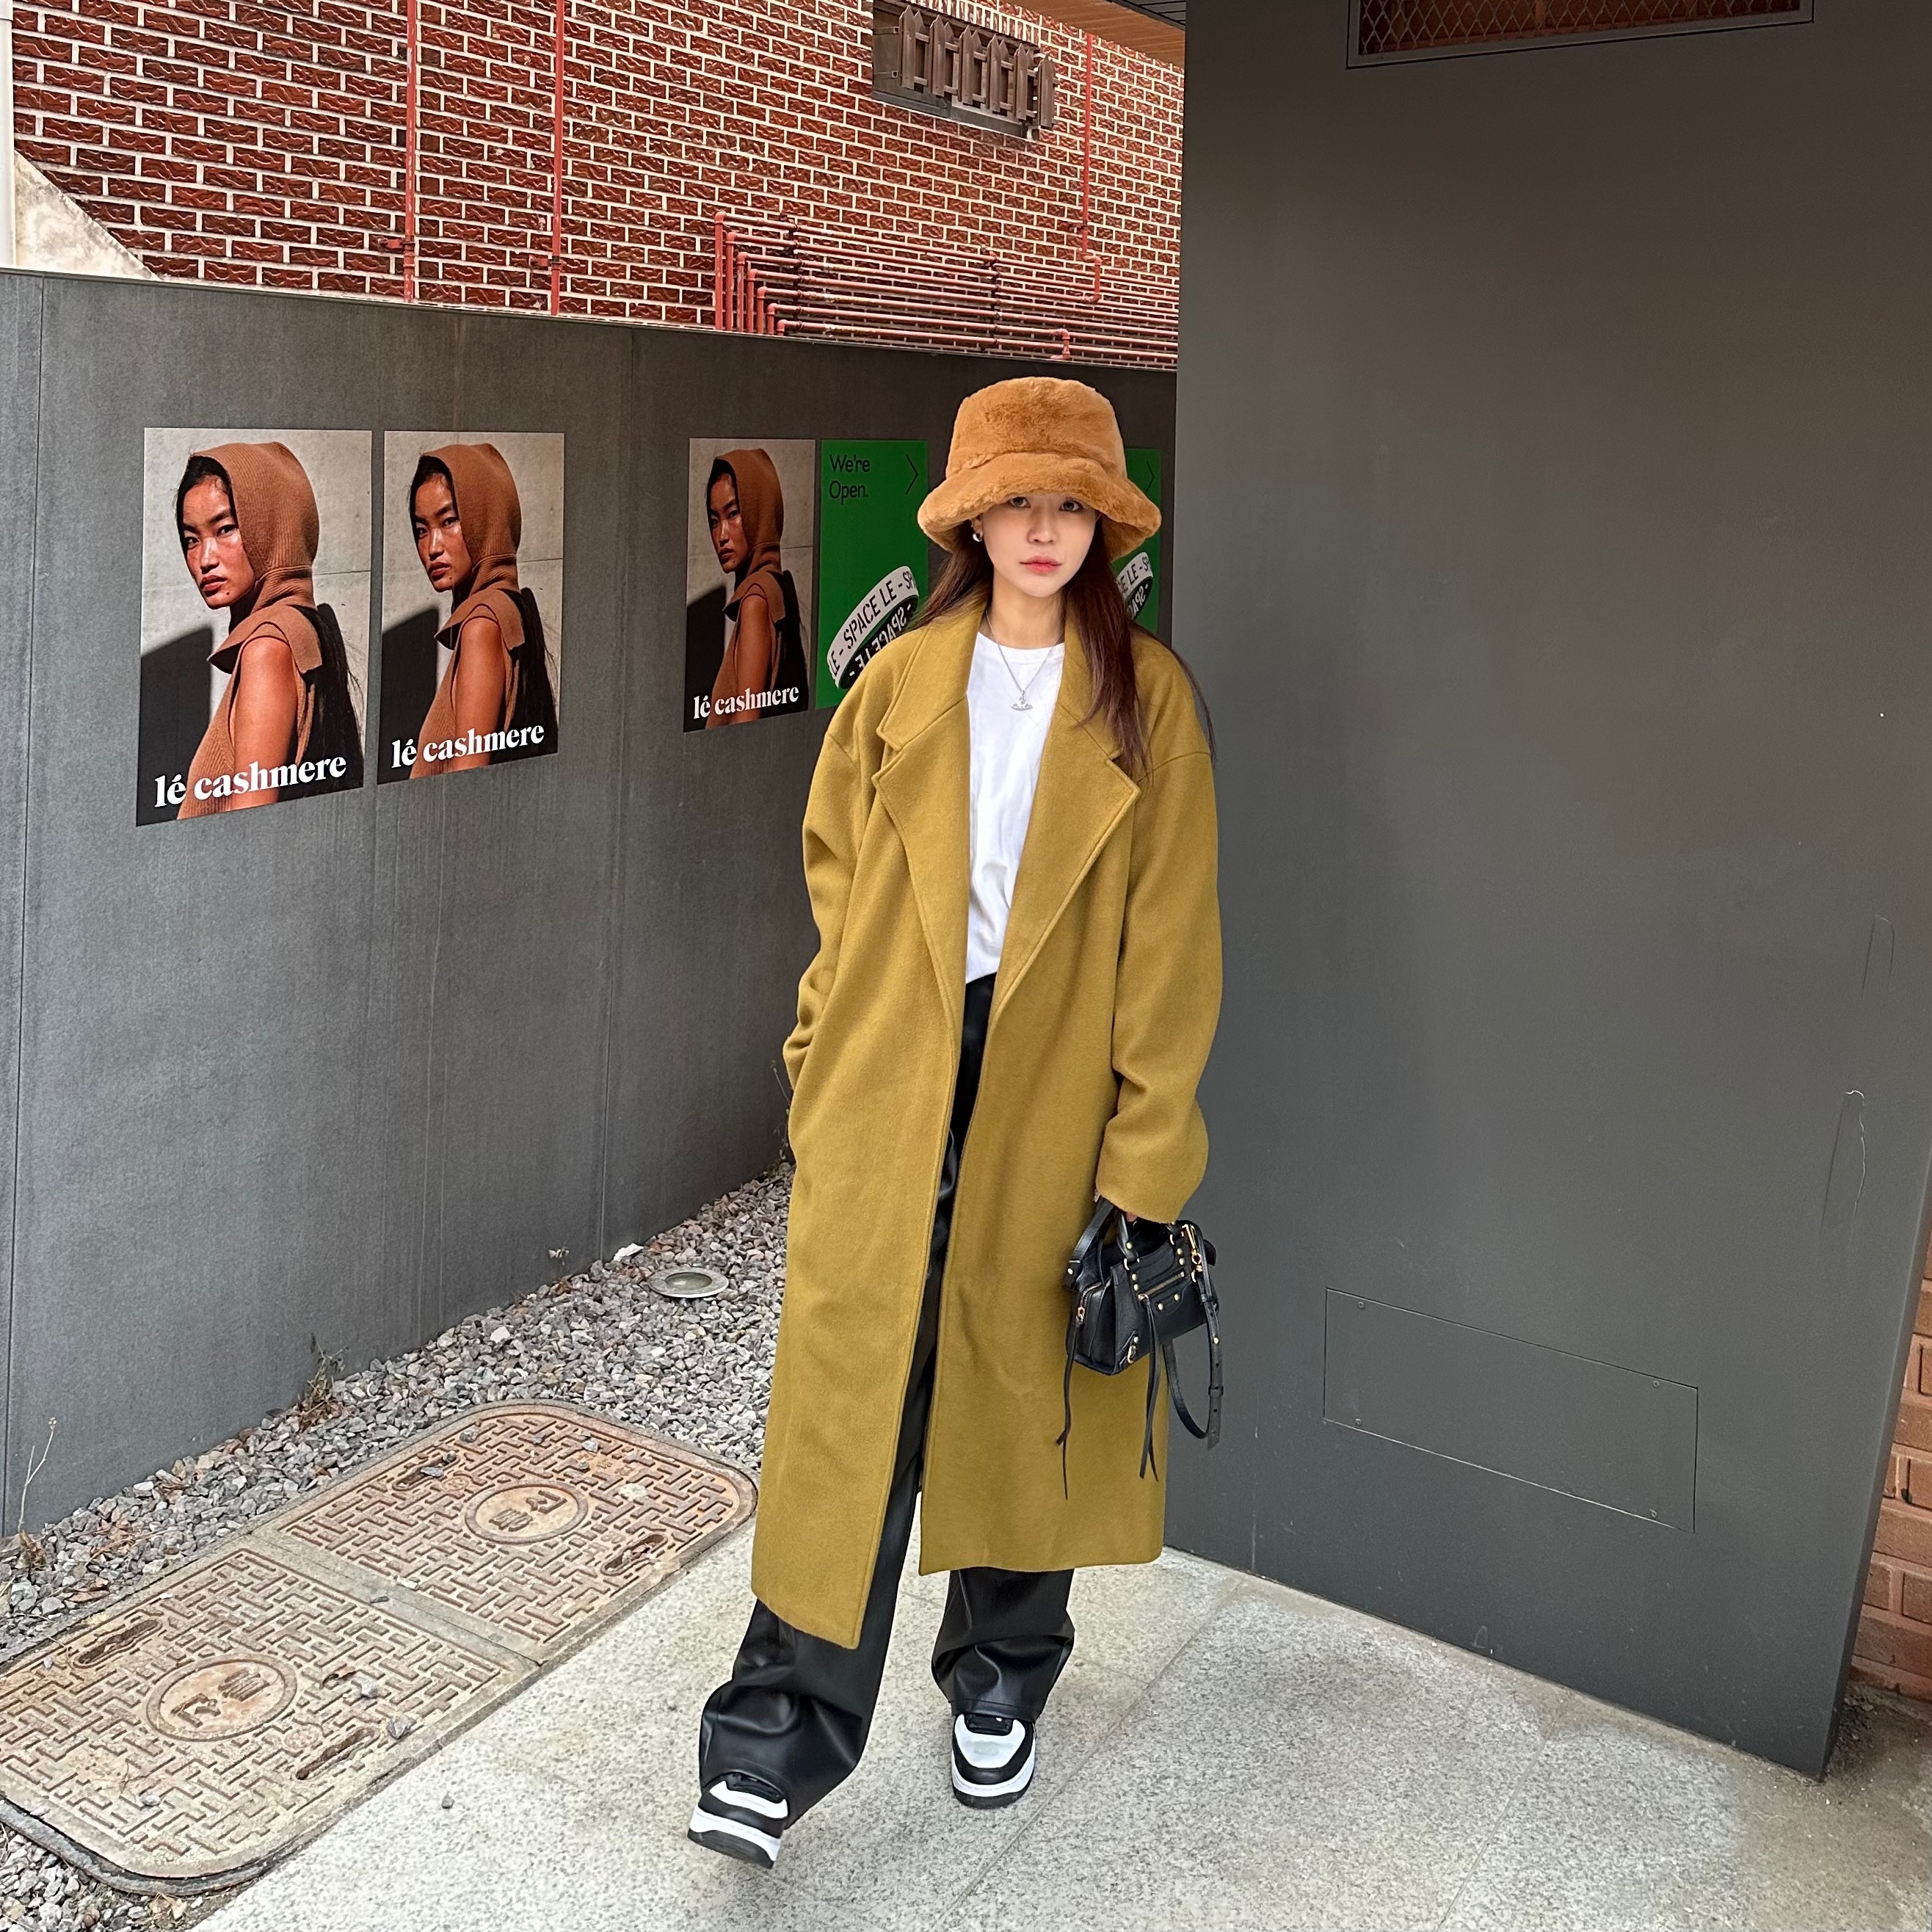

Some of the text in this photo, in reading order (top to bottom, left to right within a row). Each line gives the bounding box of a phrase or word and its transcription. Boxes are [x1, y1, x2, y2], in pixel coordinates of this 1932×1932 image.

[829, 454, 871, 473] We're
[829, 480, 869, 505] Open.
[1126, 563, 1139, 585] LE
[843, 595, 881, 650] SPACE
[879, 580, 897, 607] LE
[693, 686, 799, 719] lé cashmere
[391, 723, 545, 769] lé cashmere
[154, 754, 347, 807] lé cashmere
